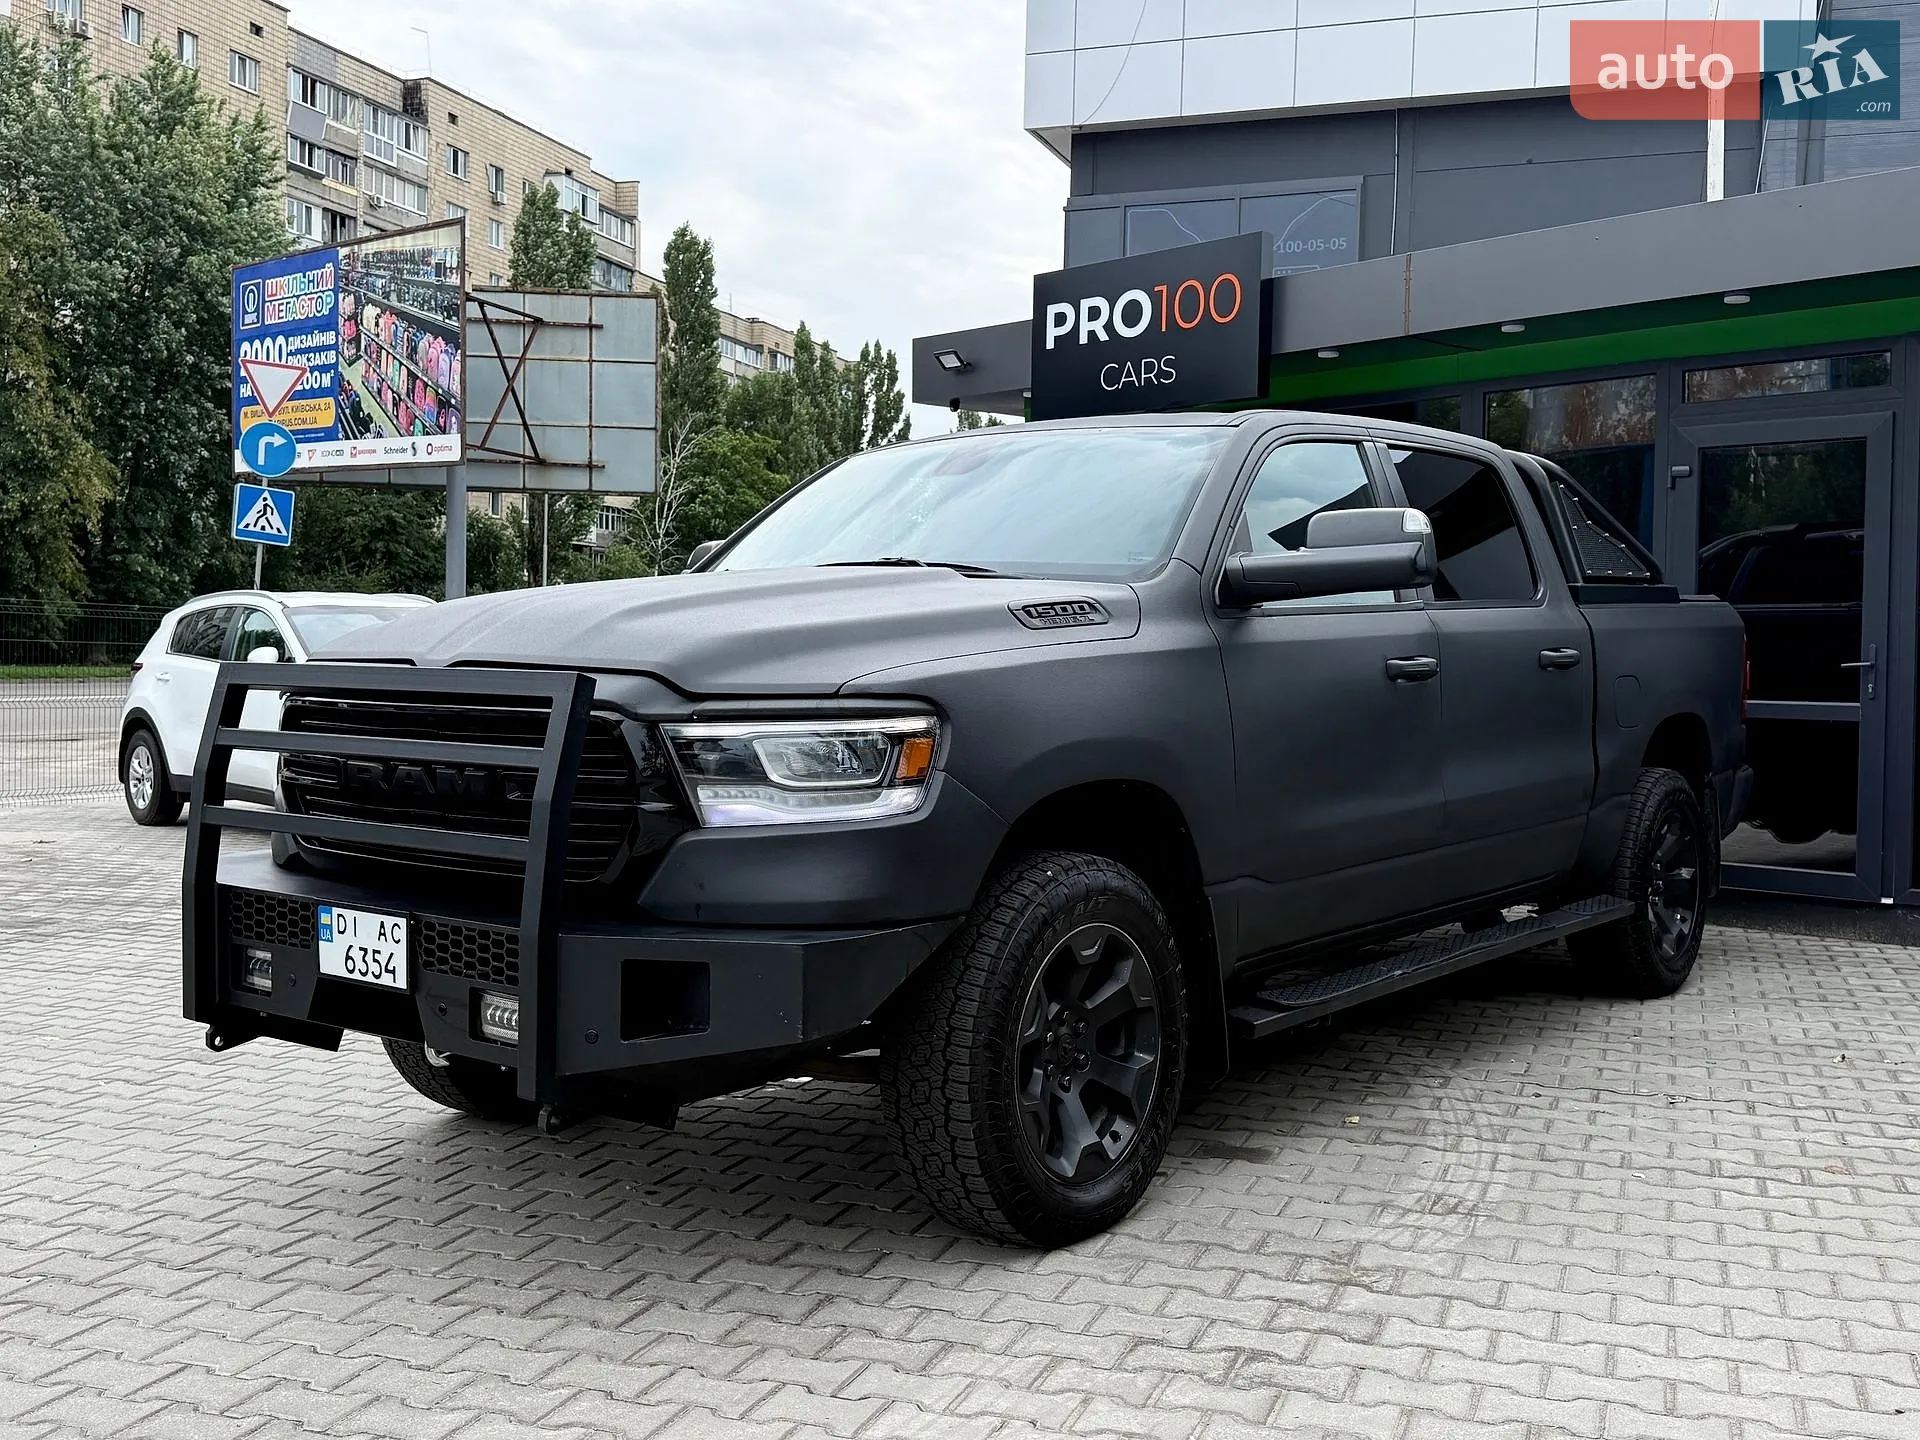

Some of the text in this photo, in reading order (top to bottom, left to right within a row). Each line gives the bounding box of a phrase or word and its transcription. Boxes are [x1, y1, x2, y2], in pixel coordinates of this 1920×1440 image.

[1277, 237, 1347, 253] 100-05-05
[264, 262, 335, 300] ШКІЛЬНИЙ
[264, 290, 335, 325] МЕГАСТОР
[1045, 272, 1243, 350] PRO100
[287, 330, 336, 353] ДИЗАЙНІВ
[287, 350, 336, 368] РЮКЗАКІВ
[1100, 355, 1176, 391] CARS
[384, 447, 408, 455] Schneider
[434, 445, 452, 453] optima
[1024, 603, 1091, 617] 1500
[347, 760, 492, 799] RAM
[321, 929, 331, 940] UA
[337, 913, 401, 944] DI AC
[344, 944, 396, 984] 6354
